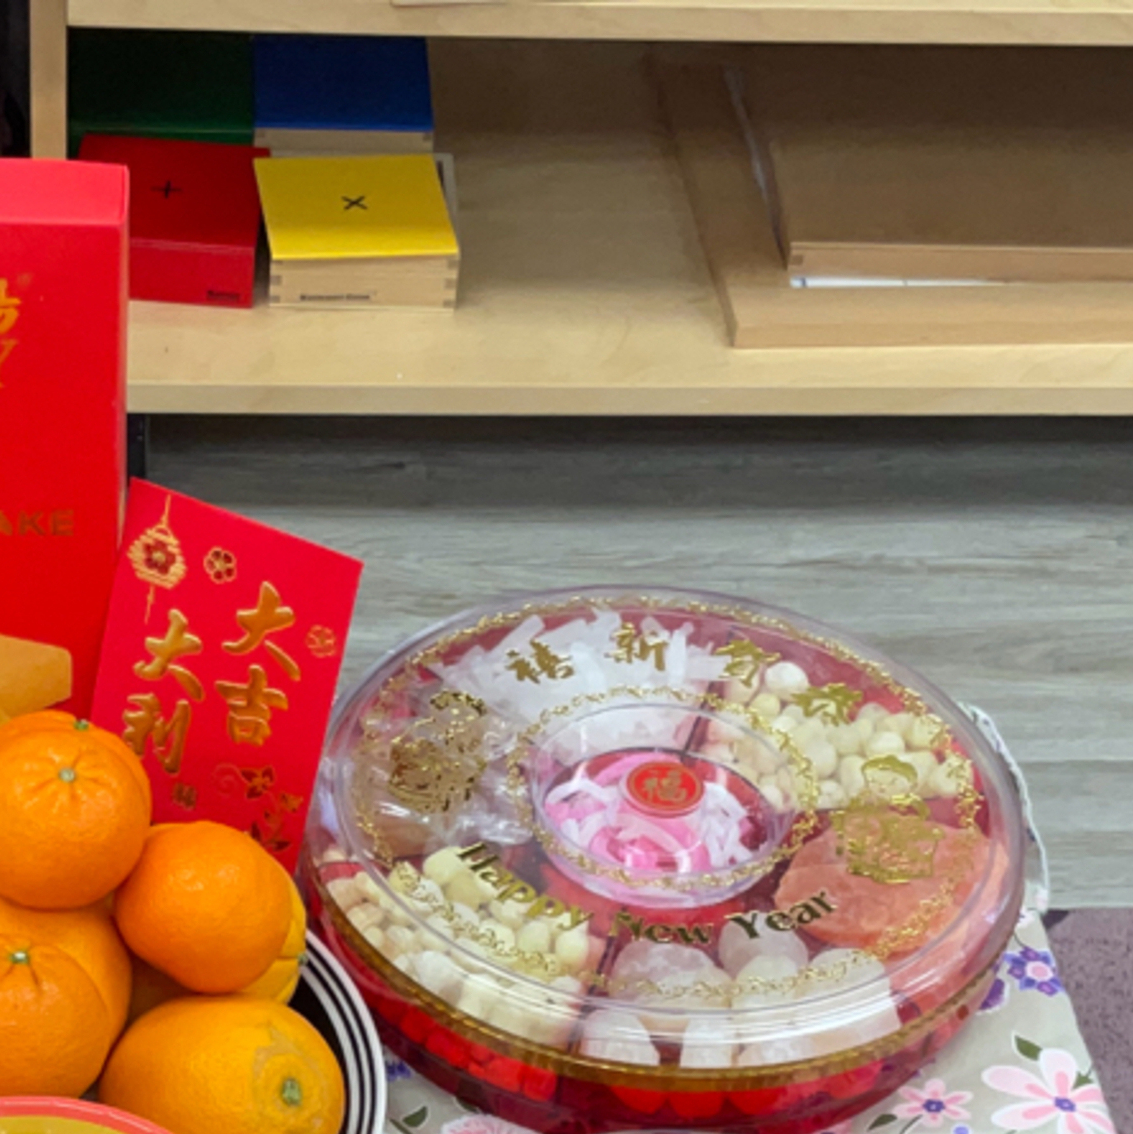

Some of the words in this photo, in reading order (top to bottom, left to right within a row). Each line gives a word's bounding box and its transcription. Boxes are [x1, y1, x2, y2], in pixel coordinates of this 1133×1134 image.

[457, 841, 593, 931] Happy
[609, 907, 713, 944] New
[727, 890, 837, 940] Year
